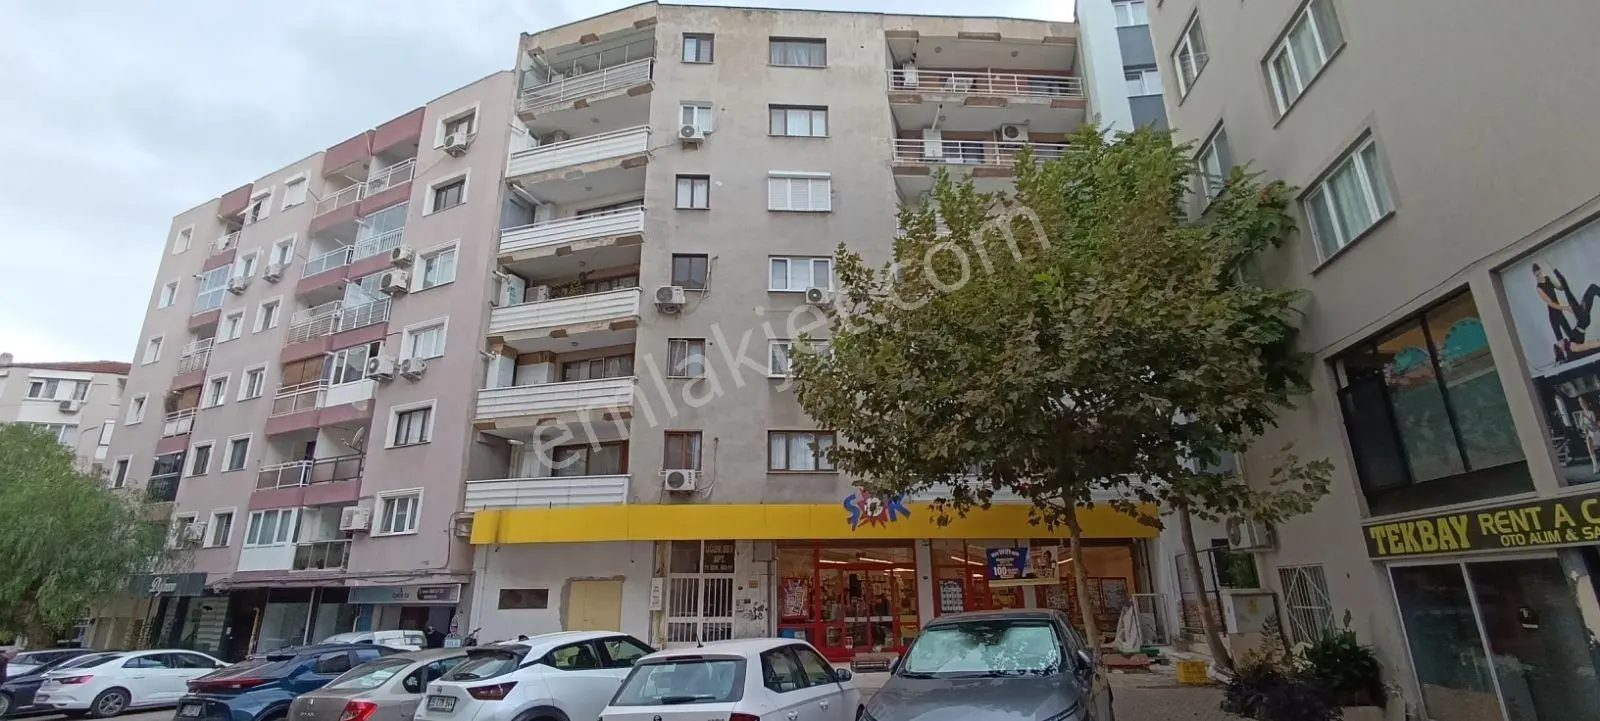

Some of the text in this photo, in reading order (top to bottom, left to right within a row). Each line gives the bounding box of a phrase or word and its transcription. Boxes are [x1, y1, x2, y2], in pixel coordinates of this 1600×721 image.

[1369, 514, 1472, 555] TEKBAY
[1478, 506, 1542, 535] RENT
[1554, 503, 1577, 528] A
[1501, 534, 1526, 547] OTO
[1529, 529, 1562, 545] ALIM
[1565, 528, 1580, 541] &
[993, 566, 1007, 576] 100
